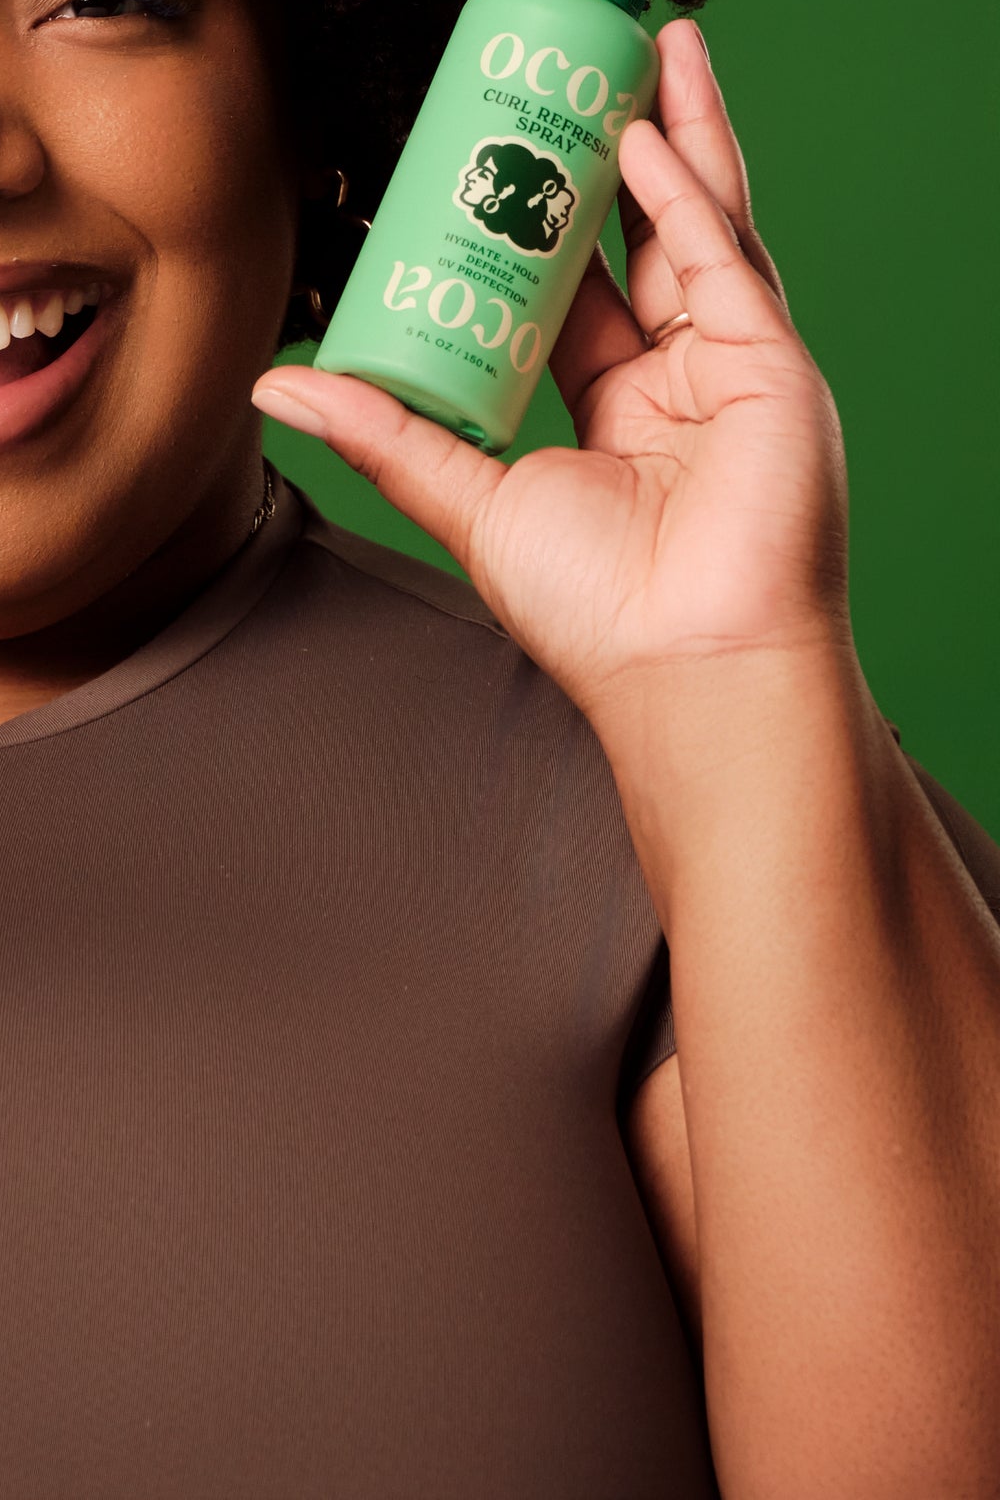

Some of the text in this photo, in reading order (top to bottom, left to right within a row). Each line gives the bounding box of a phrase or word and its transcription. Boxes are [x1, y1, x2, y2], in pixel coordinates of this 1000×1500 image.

[483, 88, 611, 161] CURL REFRESH
[516, 116, 578, 155] SPRAY
[438, 256, 529, 308] UV PROTECTION
[445, 232, 501, 263] HYDRATE
[513, 261, 540, 285] HOLD
[466, 254, 515, 284] DEFRIZZ
[383, 260, 541, 373] ocoa
[405, 326, 413, 336] 5
[417, 330, 431, 343] FL
[435, 338, 453, 353] OZ
[464, 351, 483, 368] 150
[485, 364, 498, 379] ML
